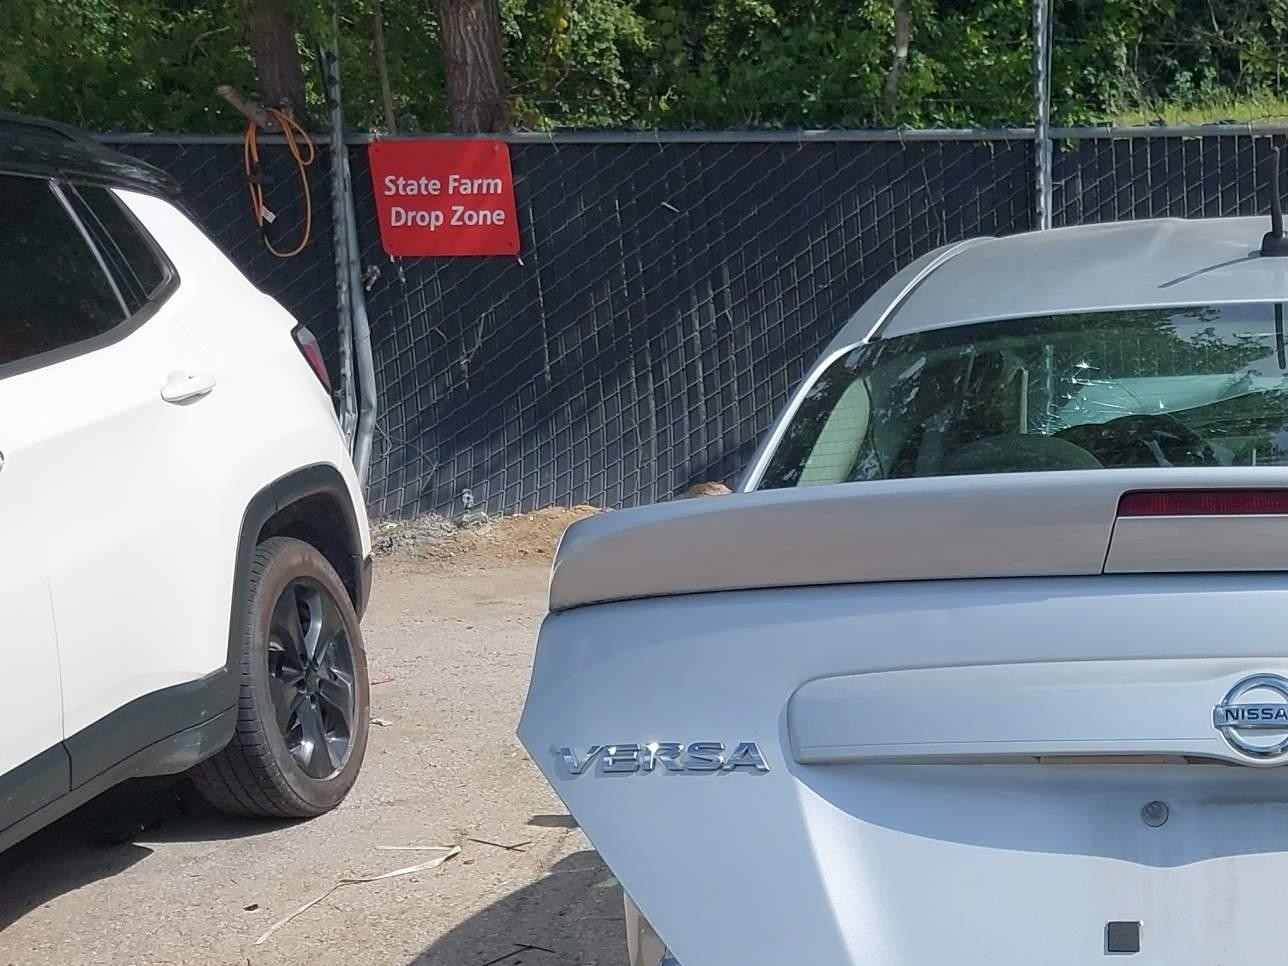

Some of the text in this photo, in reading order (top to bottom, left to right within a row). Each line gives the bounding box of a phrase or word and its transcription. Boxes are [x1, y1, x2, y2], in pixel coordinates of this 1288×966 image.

[384, 175, 503, 196] State Farm
[391, 206, 506, 231] Drop Zone
[557, 742, 770, 774] VERSA
